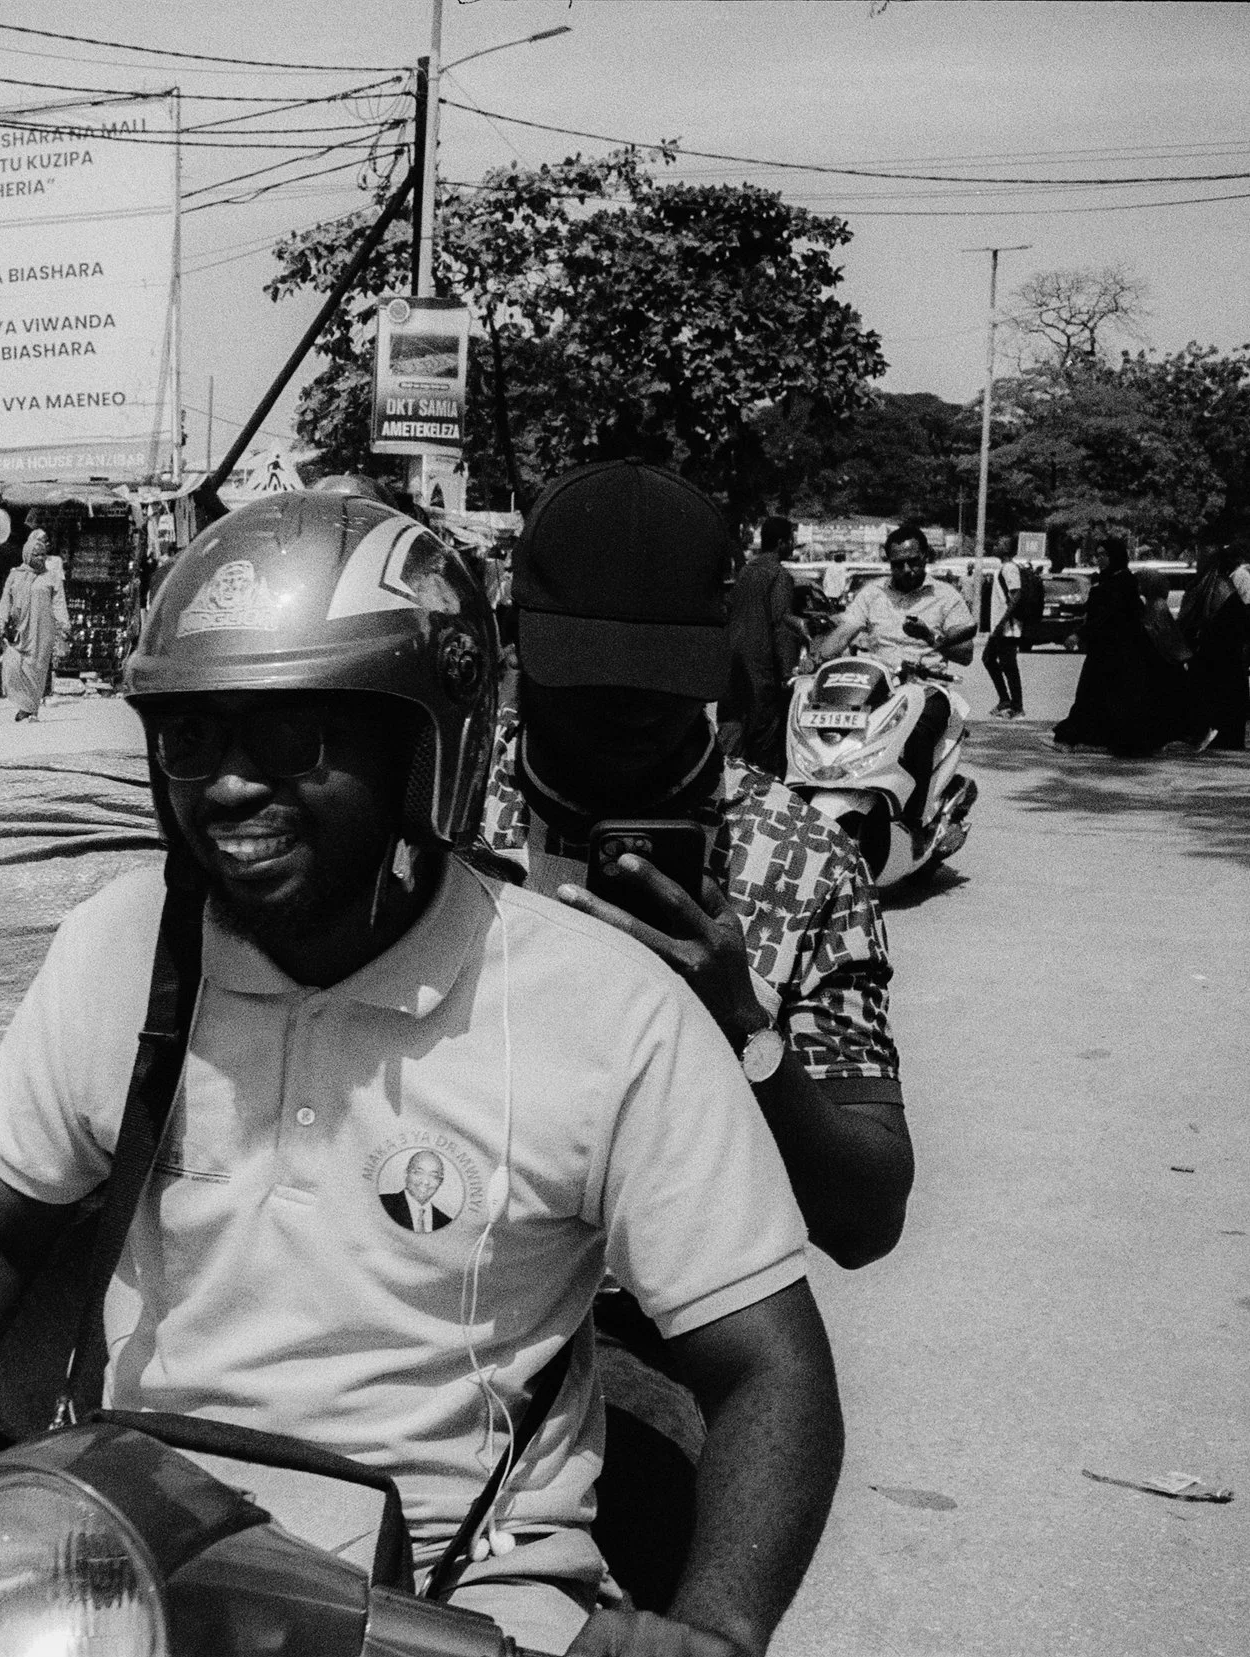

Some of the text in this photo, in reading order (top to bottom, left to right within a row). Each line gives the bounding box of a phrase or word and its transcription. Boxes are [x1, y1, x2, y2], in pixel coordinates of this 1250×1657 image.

[27, 150, 93, 171] KUZIPA
[8, 262, 104, 284] BIASHARA
[22, 314, 116, 334] VIWANDA
[1, 341, 96, 361] BIASHARA
[2, 396, 41, 412] VYA
[46, 392, 127, 410] MAENEO
[386, 398, 458, 418] DKT SAMIA
[382, 421, 460, 439] AMETEKELEZA
[29, 455, 74, 469] HOUSE
[77, 453, 145, 467] ZANZIBAR
[412, 1130, 431, 1143] YA
[456, 1151, 484, 1214] MWINYI
